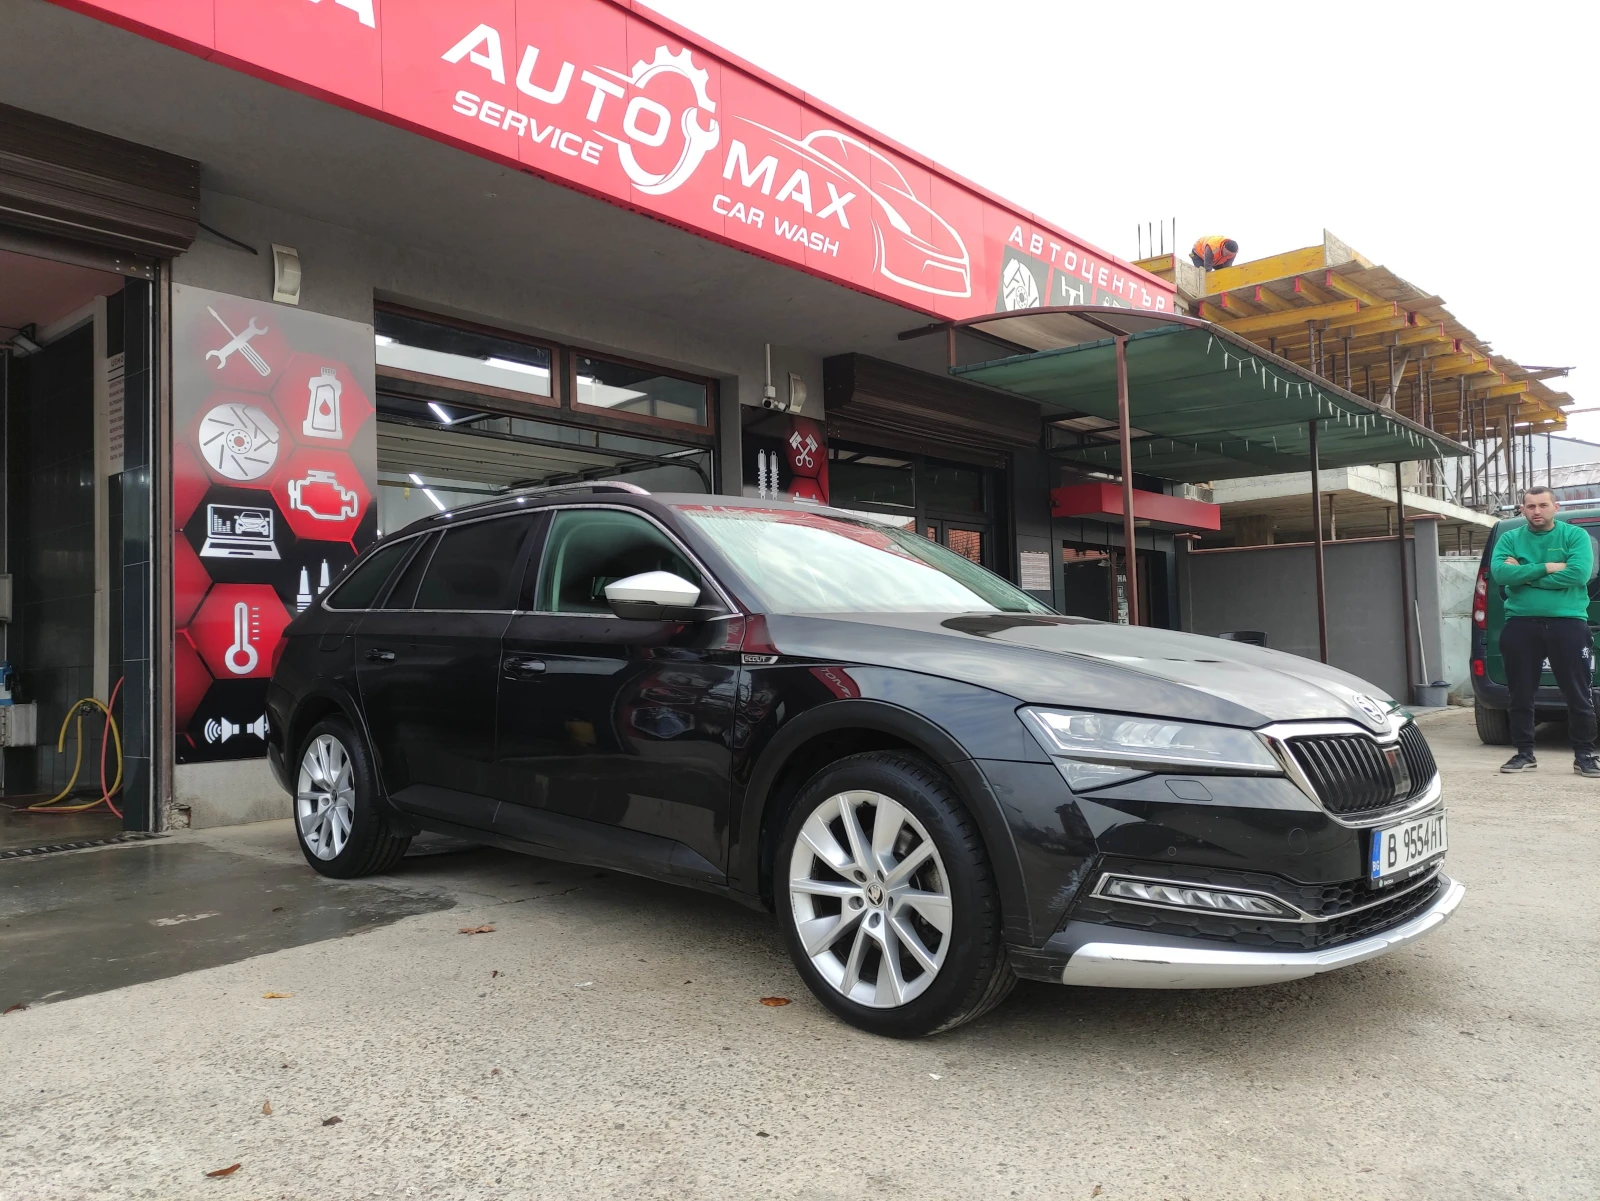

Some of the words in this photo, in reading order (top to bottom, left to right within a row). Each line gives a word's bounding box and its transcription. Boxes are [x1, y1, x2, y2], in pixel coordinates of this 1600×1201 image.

[440, 23, 671, 147] AUTO
[722, 138, 857, 230] MAX
[452, 89, 604, 165] SERVICE
[712, 193, 765, 229] CAR
[774, 216, 840, 257] WASH
[1008, 224, 1165, 311] АВТОЦЕНТЪР
[744, 655, 767, 663] SCOUT
[1372, 860, 1380, 872] BG
[1387, 833, 1397, 868] B
